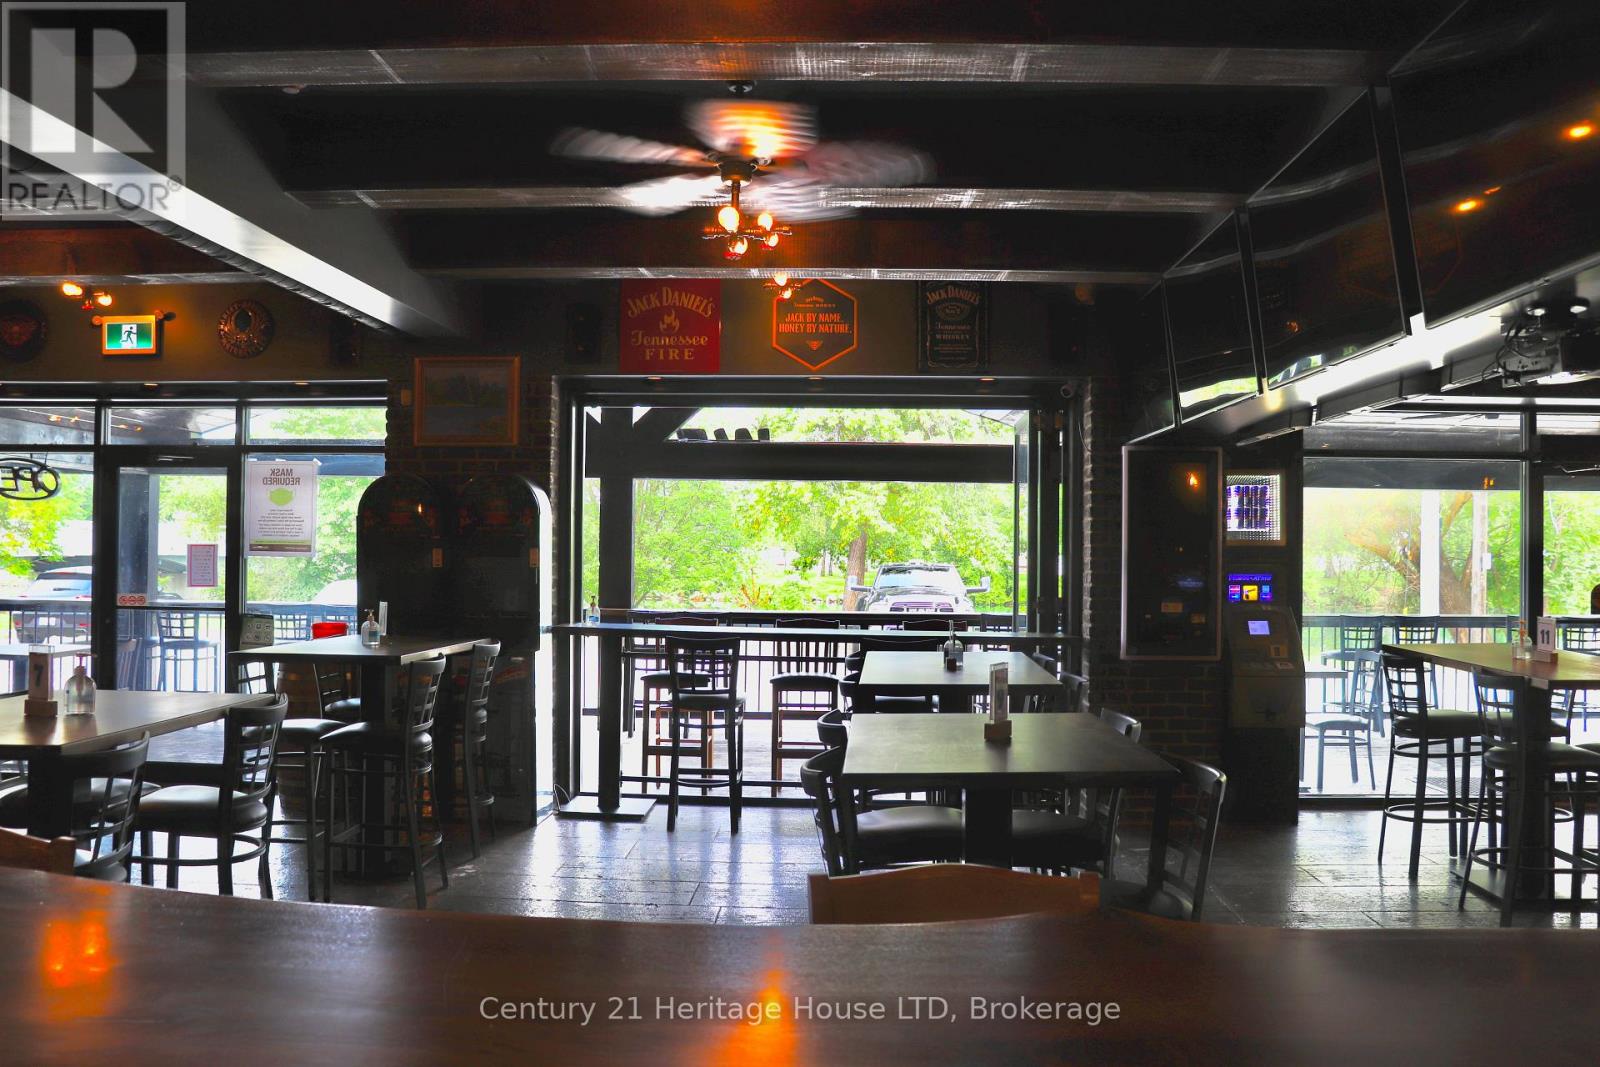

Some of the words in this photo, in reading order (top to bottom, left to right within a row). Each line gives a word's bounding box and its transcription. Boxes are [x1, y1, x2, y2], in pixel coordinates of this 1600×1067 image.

[627, 292, 660, 318] JACK
[662, 287, 715, 318] DANIEL'S
[786, 312, 804, 323] JACK
[806, 312, 817, 323] BY
[779, 323, 804, 334] HONEY
[806, 323, 817, 334] BY
[631, 330, 708, 346] Tennessee
[644, 348, 695, 360] FIRE
[1540, 629, 1550, 645] 11
[33, 663, 44, 688] 7
